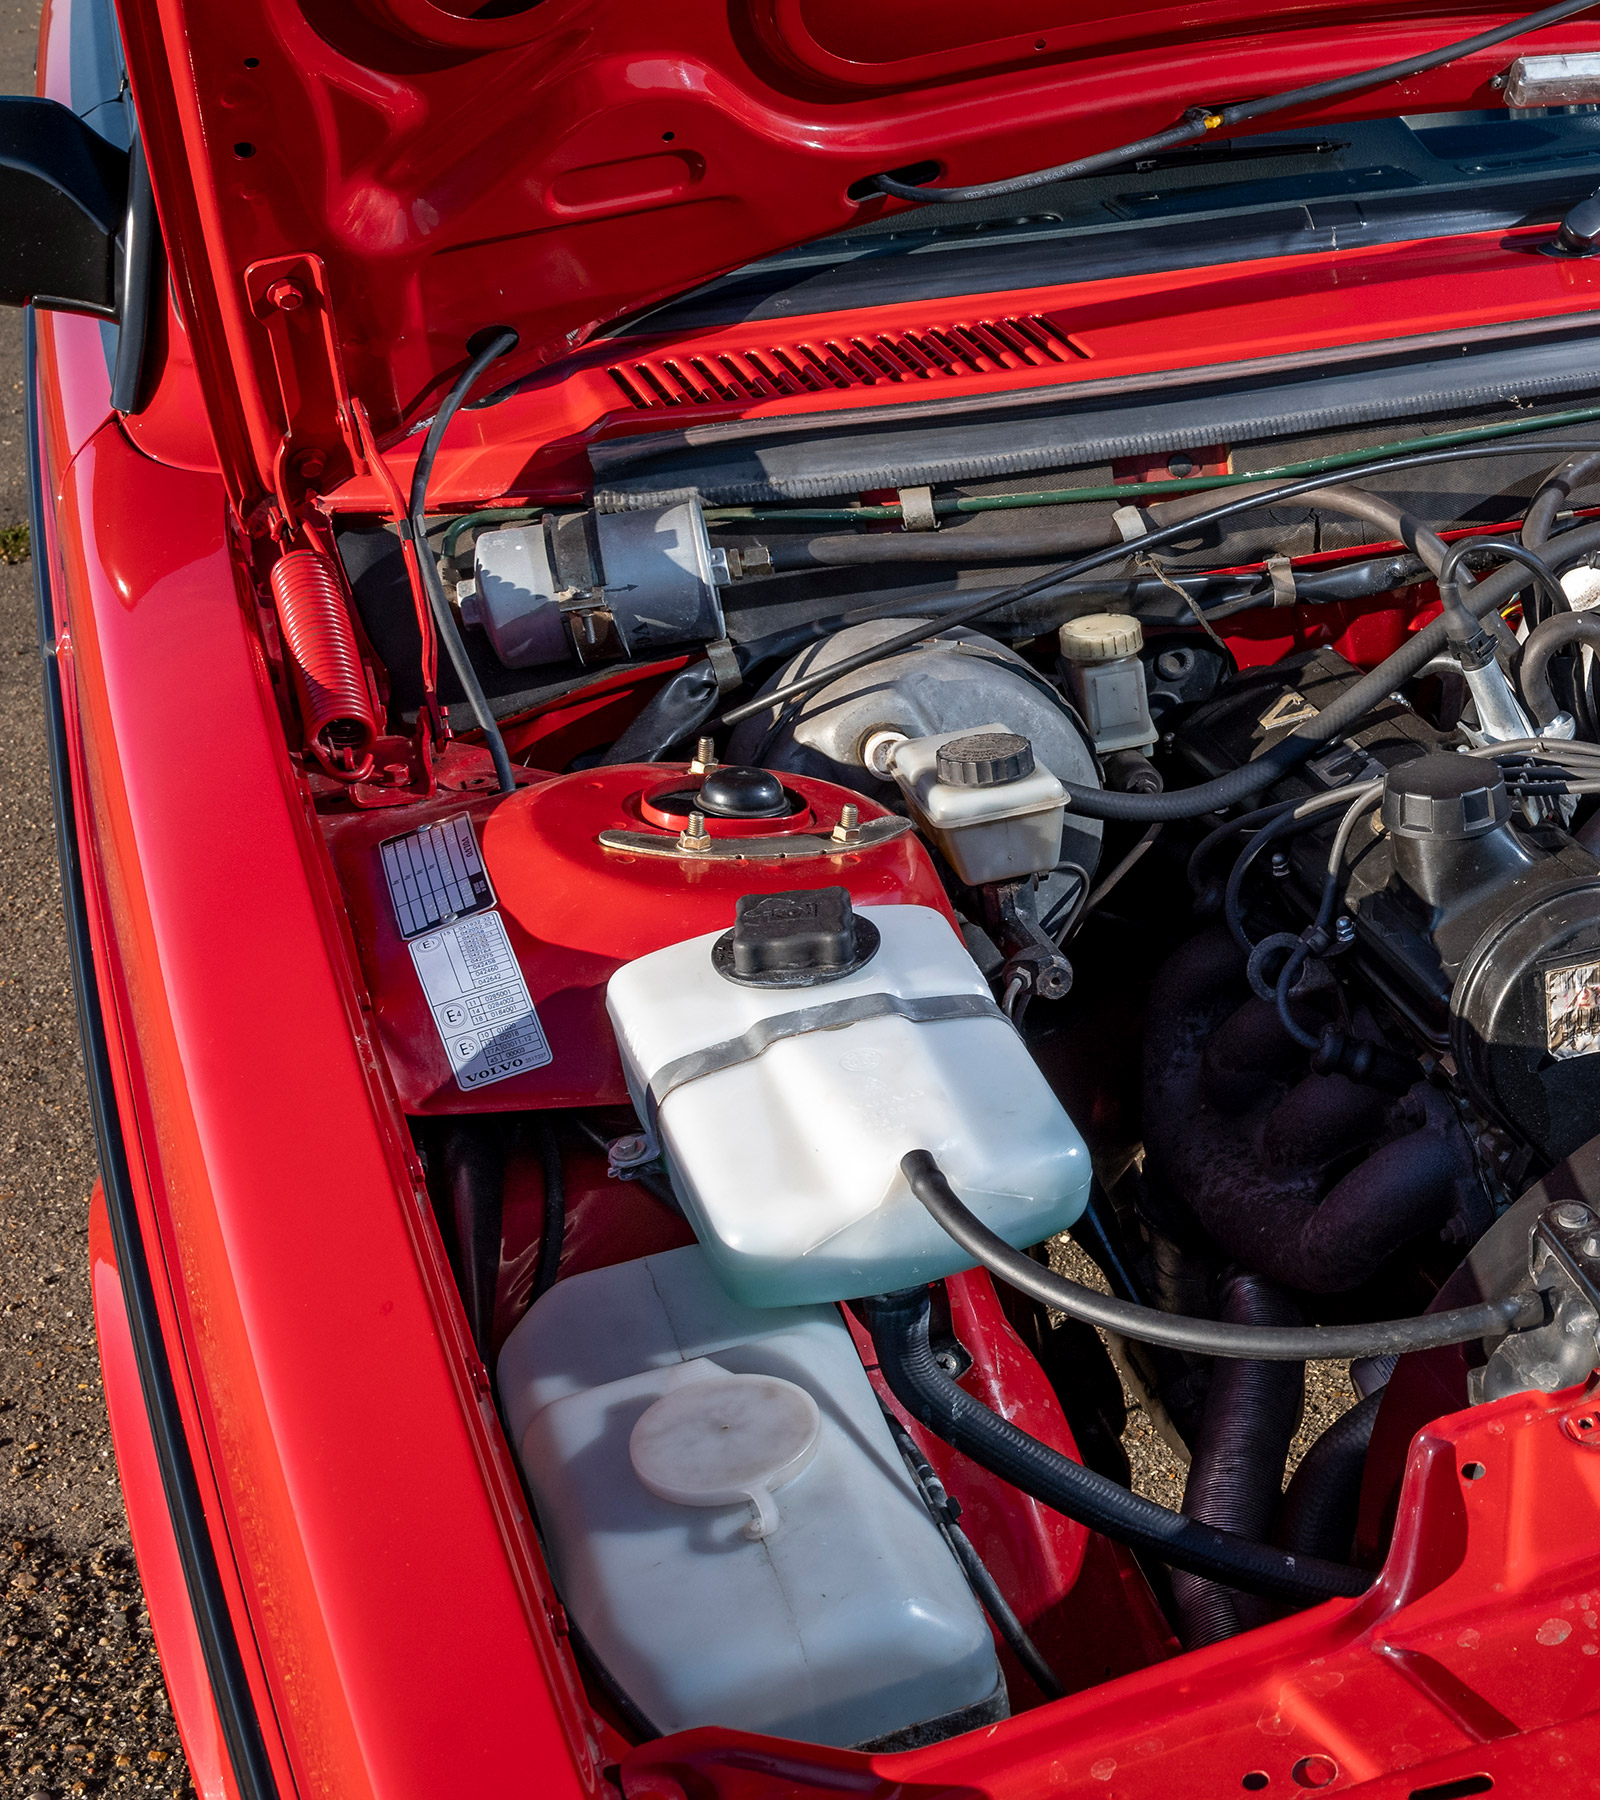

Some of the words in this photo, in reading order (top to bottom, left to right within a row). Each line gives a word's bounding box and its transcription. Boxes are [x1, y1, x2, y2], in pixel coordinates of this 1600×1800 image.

[462, 836, 474, 858] VOLVO
[474, 965, 499, 976] 042460
[477, 974, 502, 985] 042642
[484, 989, 511, 1001] 0285001
[487, 996, 514, 1010] 0284002
[446, 1009, 462, 1023] E4
[490, 1005, 517, 1018] 0184001
[481, 1031, 490, 1039] 10
[459, 1042, 475, 1056] E5
[465, 1058, 523, 1082] VOLVO
